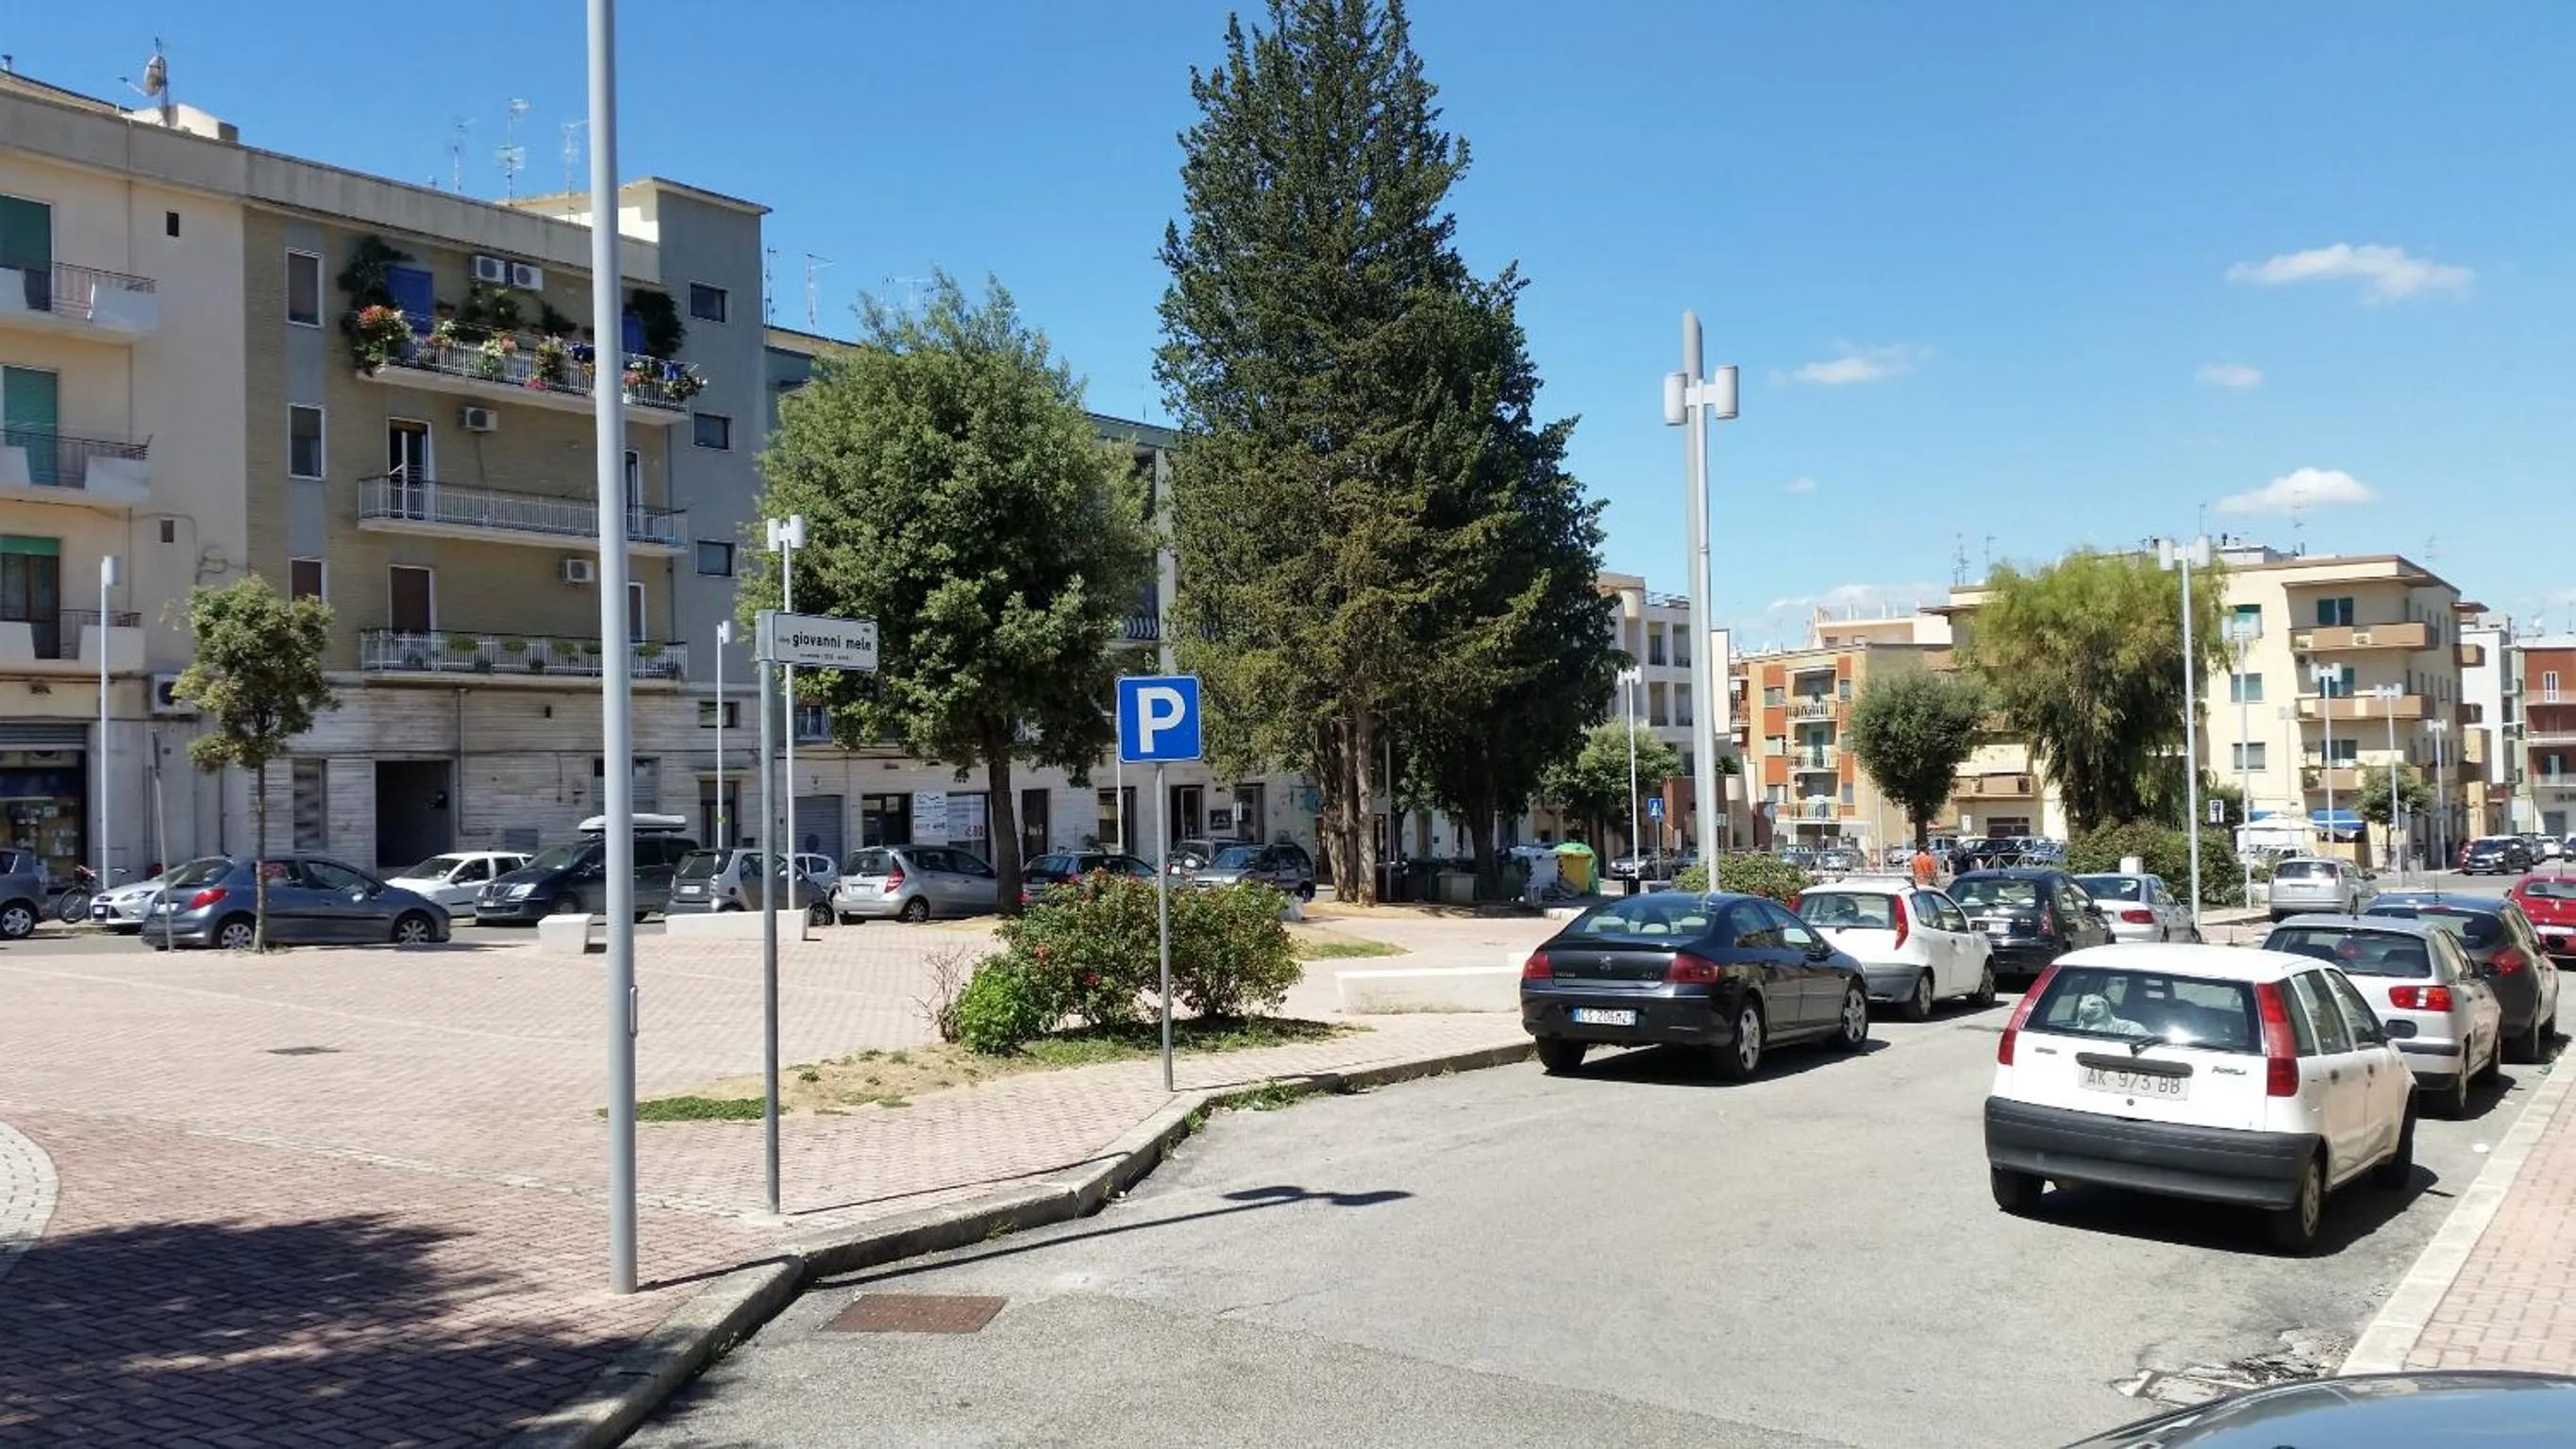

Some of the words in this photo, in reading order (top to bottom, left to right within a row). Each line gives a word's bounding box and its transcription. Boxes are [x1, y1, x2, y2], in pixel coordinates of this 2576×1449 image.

[793, 631, 841, 648] giovanni
[845, 636, 872, 651] mele
[1137, 686, 1186, 753] P
[2087, 1068, 2106, 1087] AK
[2117, 1072, 2151, 1091] 973
[2158, 1076, 2181, 1094] BB
